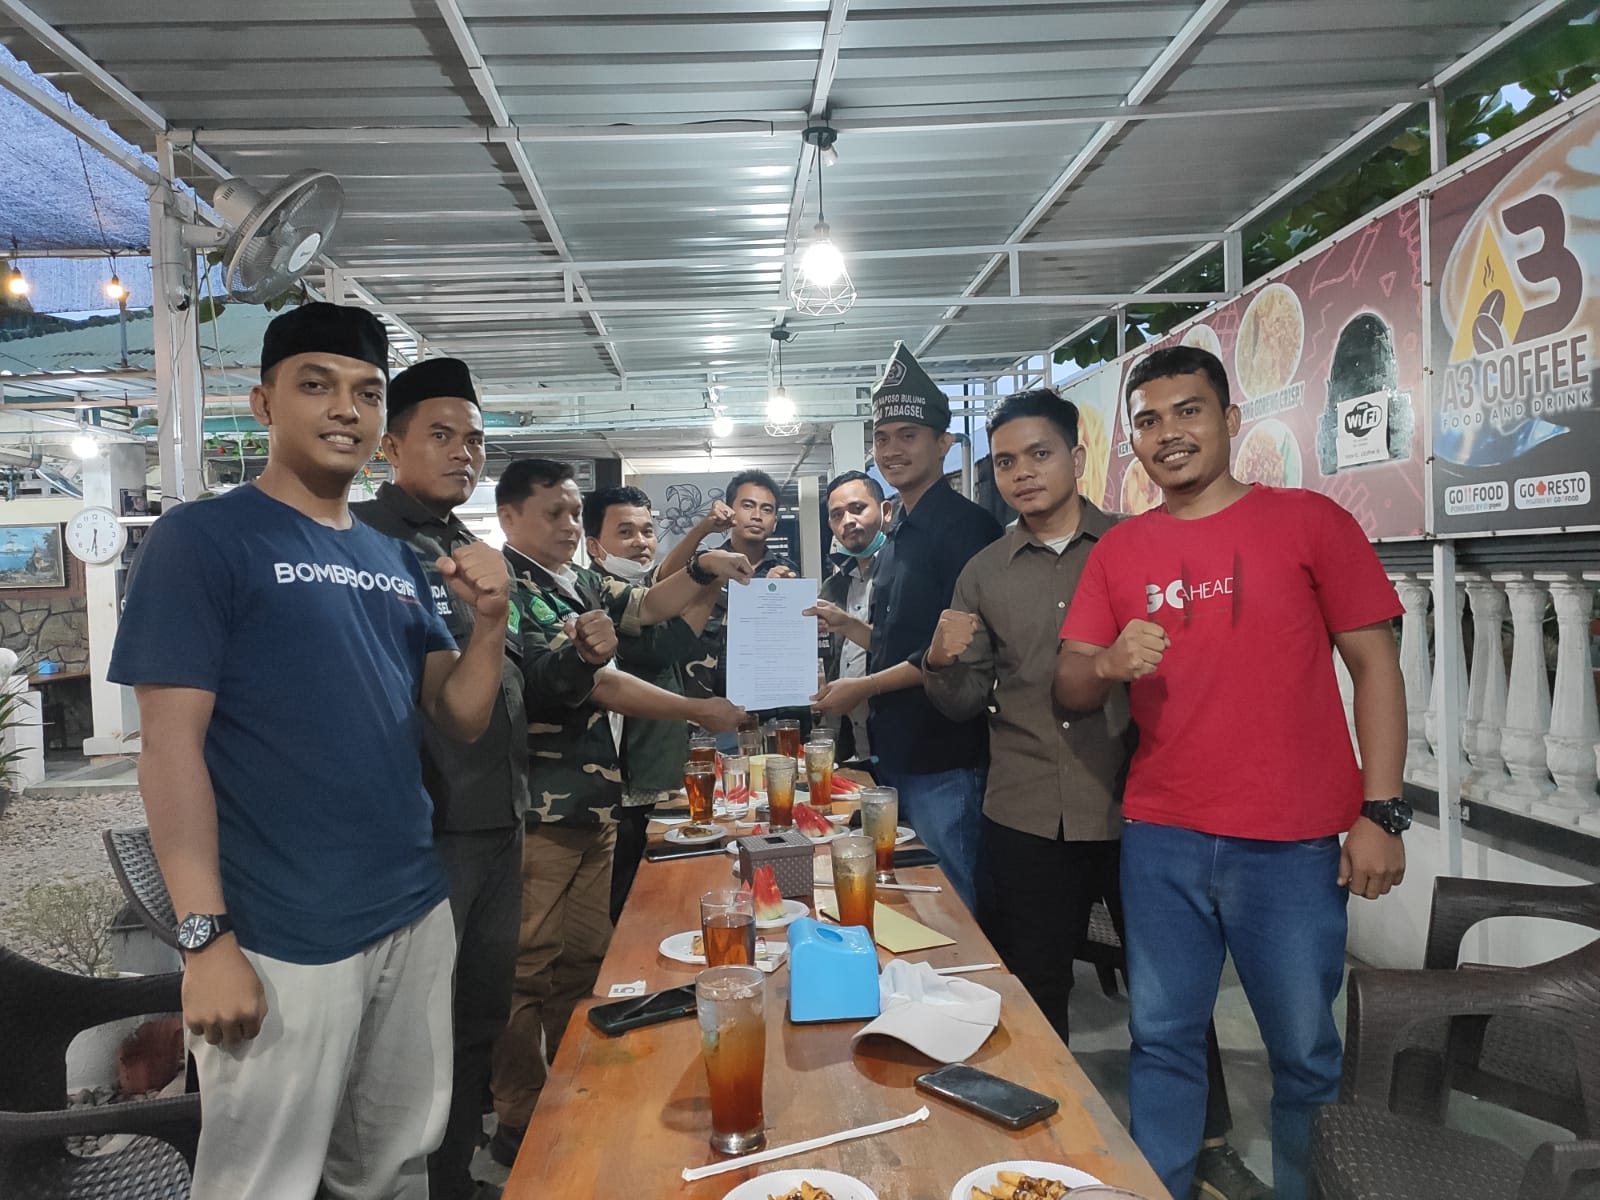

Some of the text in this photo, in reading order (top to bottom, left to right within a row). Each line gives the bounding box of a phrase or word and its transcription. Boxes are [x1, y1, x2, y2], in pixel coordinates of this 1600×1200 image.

[1443, 334, 1589, 413] A3 COFFEE
[885, 405, 924, 419] TABAGSEL
[900, 394, 926, 405] BULUNG
[1443, 390, 1590, 429] FOOD AND DRINK
